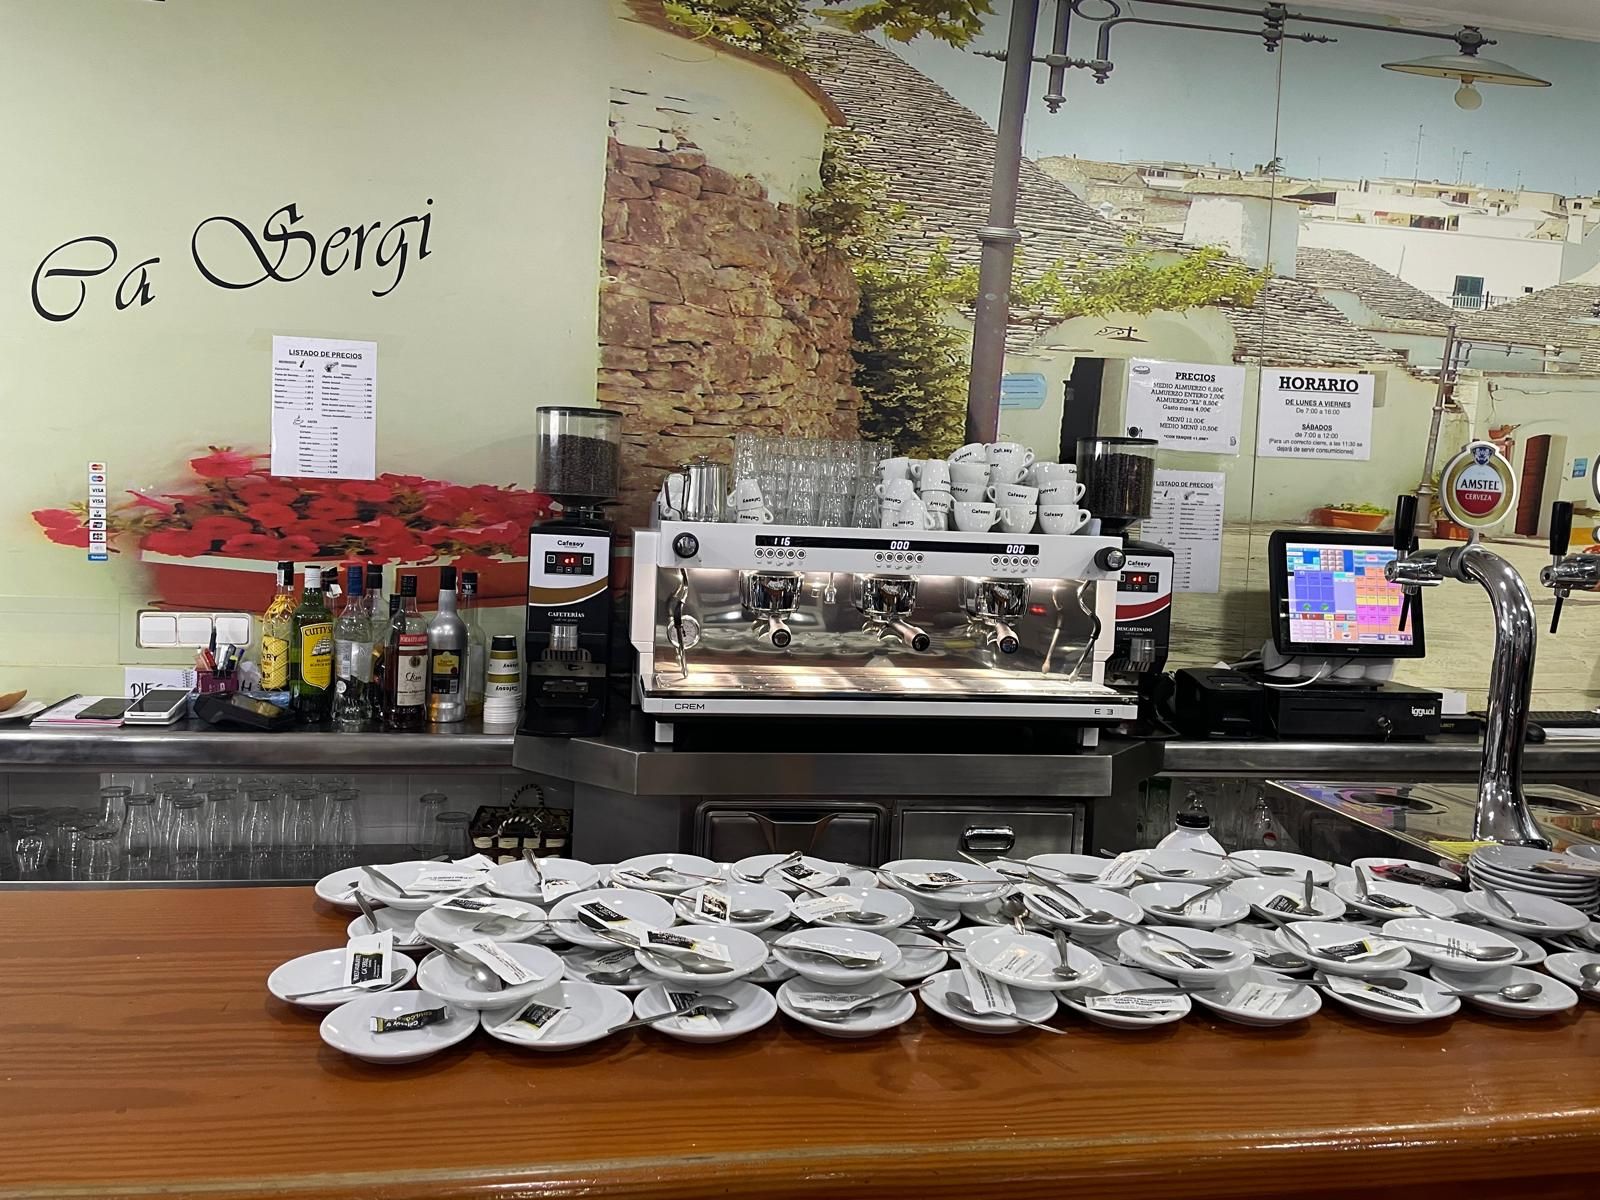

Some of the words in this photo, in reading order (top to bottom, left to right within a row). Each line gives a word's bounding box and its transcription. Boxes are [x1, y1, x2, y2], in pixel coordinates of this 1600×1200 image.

[31, 236, 160, 321] Ca
[192, 198, 434, 298] Sergi
[289, 349, 319, 357] LISTADO
[331, 352, 362, 360] PRECIOS
[1175, 372, 1216, 382] PRECIOS
[1279, 376, 1359, 392] HORARIO
[1151, 389, 1183, 397] ALMUERZO
[1302, 422, 1332, 431] SÁBADOS
[1460, 479, 1499, 491] AMSTEL
[1464, 493, 1492, 501] CERVEZA
[890, 540, 910, 550] 000
[1006, 545, 1026, 554] 000
[1411, 706, 1436, 717] iggual
